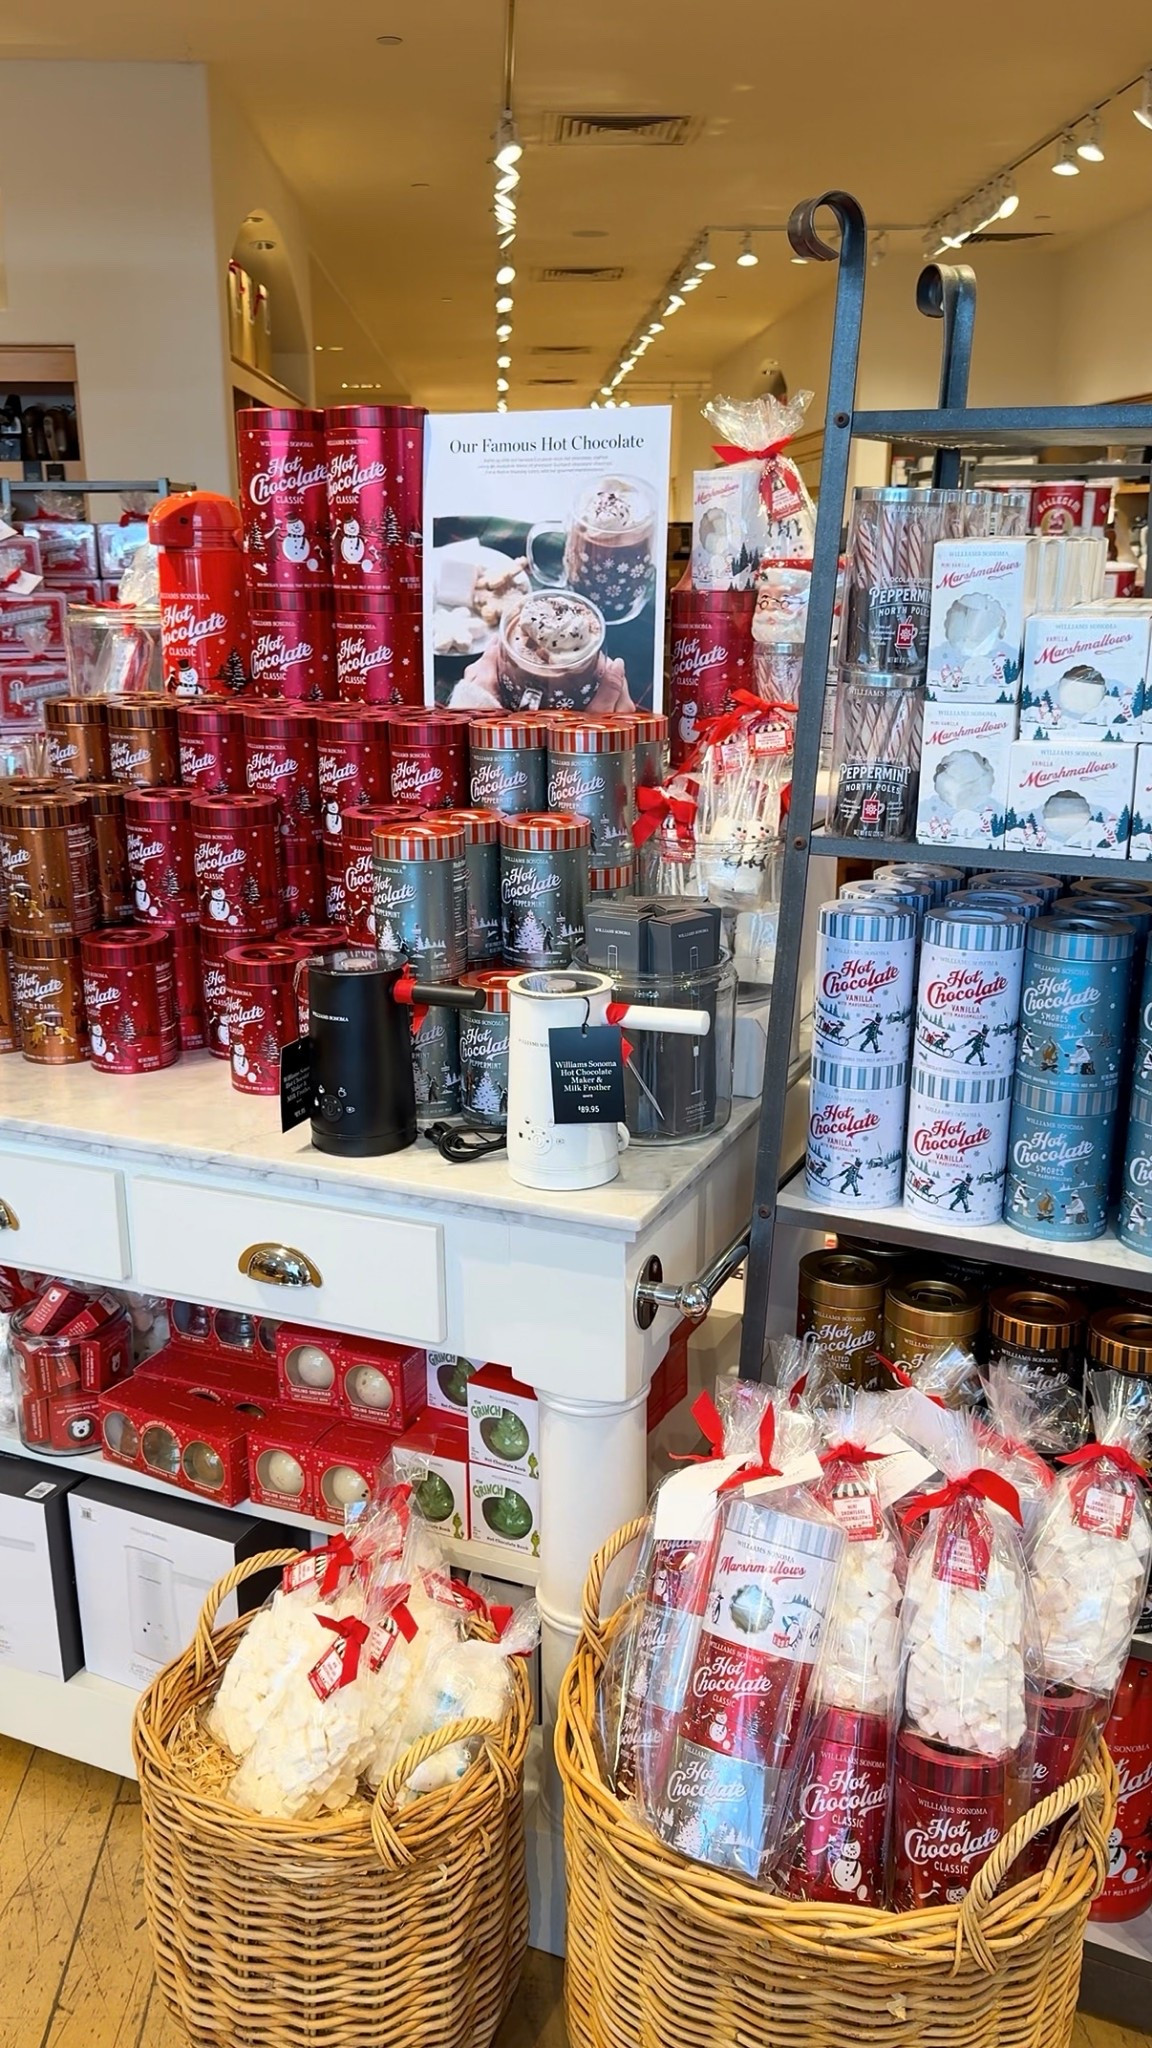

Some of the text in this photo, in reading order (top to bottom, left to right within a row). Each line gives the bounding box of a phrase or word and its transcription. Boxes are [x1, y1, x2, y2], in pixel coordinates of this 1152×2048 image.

[450, 433, 645, 455] Our Famous Hot Chocolate
[267, 455, 303, 479] Hot
[330, 453, 359, 478] Hot
[249, 462, 331, 506] Chocolate
[275, 496, 304, 505] CLASSIC
[335, 495, 360, 505] CLASSIC
[949, 550, 1009, 559] WILLIAMS SONOMA
[936, 561, 1022, 589] Marshmallows
[162, 604, 194, 630] Hot
[878, 606, 908, 617] NORTH
[1055, 623, 1117, 633] WILLIAMS SONOMA
[257, 634, 285, 656] Hot
[339, 637, 365, 659] Hot
[673, 637, 700, 660] Hot
[1033, 633, 1133, 665] Marshmallows
[1046, 636, 1068, 645] VANILLA
[169, 647, 197, 657] CLASSIC
[251, 641, 314, 680] Chocolate
[261, 671, 287, 681] CLASSIC
[344, 675, 367, 685] CLASSIC
[676, 676, 699, 687] CLASSIC
[848, 686, 885, 698] WILLIAMS
[938, 709, 998, 718] WILLIAMS SONOMA
[925, 719, 1009, 747] Marshmallows
[252, 752, 275, 771] Hot
[1040, 749, 1103, 760] WILLIAMS SONOMA
[396, 761, 420, 779] Hot
[479, 764, 505, 785] Hot
[839, 763, 911, 786] PEPPERMINT
[1031, 761, 1053, 770] VANILLA
[556, 769, 582, 789] Hot
[1019, 761, 1118, 789] Marshmallows
[256, 782, 277, 791] CLASSIC
[471, 770, 528, 803] Chocolate
[548, 776, 607, 808] Chocolate
[845, 782, 901, 795] NORTH POLES
[400, 791, 422, 801] CLASSIC
[199, 842, 222, 861] Hot
[203, 871, 224, 881] CLASSIC
[373, 874, 392, 892] Hot
[509, 866, 537, 886] Hot
[501, 873, 562, 905] Chocolate
[595, 927, 614, 935] WILLIAMS
[841, 958, 876, 979] Hot
[1033, 963, 1090, 977] WILLIAMS SONOMA
[17, 972, 39, 990] Hot
[822, 966, 900, 999] Chocolate
[947, 968, 983, 989] Hot
[1038, 976, 1072, 997] Hot
[845, 993, 873, 1004] VANILLA
[927, 976, 1009, 1010] Chocolate
[39, 1002, 57, 1010] DARK
[951, 1003, 980, 1015] VANILLA
[1022, 987, 1101, 1018] Chocolate
[1041, 1012, 1069, 1024] S'MORES
[466, 1027, 492, 1046] Hot
[459, 1037, 509, 1063] Chocolat
[470, 1053, 502, 1063] PEPPERMINT
[555, 1060, 617, 1069] Williams Sonoma
[560, 1068, 612, 1077] Hot Chocolate
[563, 1083, 611, 1092] Milk Frother
[596, 1076, 603, 1084] &
[577, 1105, 600, 1113] $89.95
[823, 1103, 855, 1123] Hot
[810, 1112, 881, 1141] Chocolate
[932, 1119, 967, 1140] Hot
[1026, 1117, 1085, 1131] WILLIAMS SONOMA
[827, 1136, 853, 1148] VANILLA
[913, 1127, 992, 1157] Chocolate
[1031, 1131, 1067, 1150] Hot
[936, 1152, 964, 1164] VANILLA
[1013, 1141, 1095, 1169] Chocolate
[1036, 1164, 1064, 1177] S'MORES
[813, 1309, 866, 1323] WILLIAMS SONOMA
[803, 1330, 877, 1353] Chocolate
[819, 1323, 852, 1344] Hot
[904, 1338, 935, 1350] WILLIAMS
[428, 1351, 456, 1366] GRINCH
[1001, 1348, 1059, 1364] WILLIAMS SONOMA
[471, 1404, 502, 1420] GRINCH
[473, 1484, 505, 1499] GRINCH
[736, 1539, 795, 1567] WILLIAMS SONOMA
[710, 1640, 763, 1665] WILLIAMS SONOMA
[711, 1656, 749, 1677] Hot
[692, 1666, 772, 1699] Chocolate
[711, 1695, 735, 1708] CLASSIC
[1113, 1743, 1150, 1758] SONOMA
[820, 1750, 885, 1770] WILLIAMS SONOMA
[667, 1771, 747, 1804] Chocolate
[828, 1768, 871, 1794] Hot
[800, 1783, 889, 1821] Chocolat
[918, 1797, 988, 1815] WILLIAMS SONOMA
[831, 1814, 865, 1829] CLASSIC
[926, 1818, 972, 1842] Hot
[903, 1827, 1001, 1866] Chocolate
[934, 1859, 969, 1877] CLASSIC
[1113, 1888, 1127, 1898] MELT
